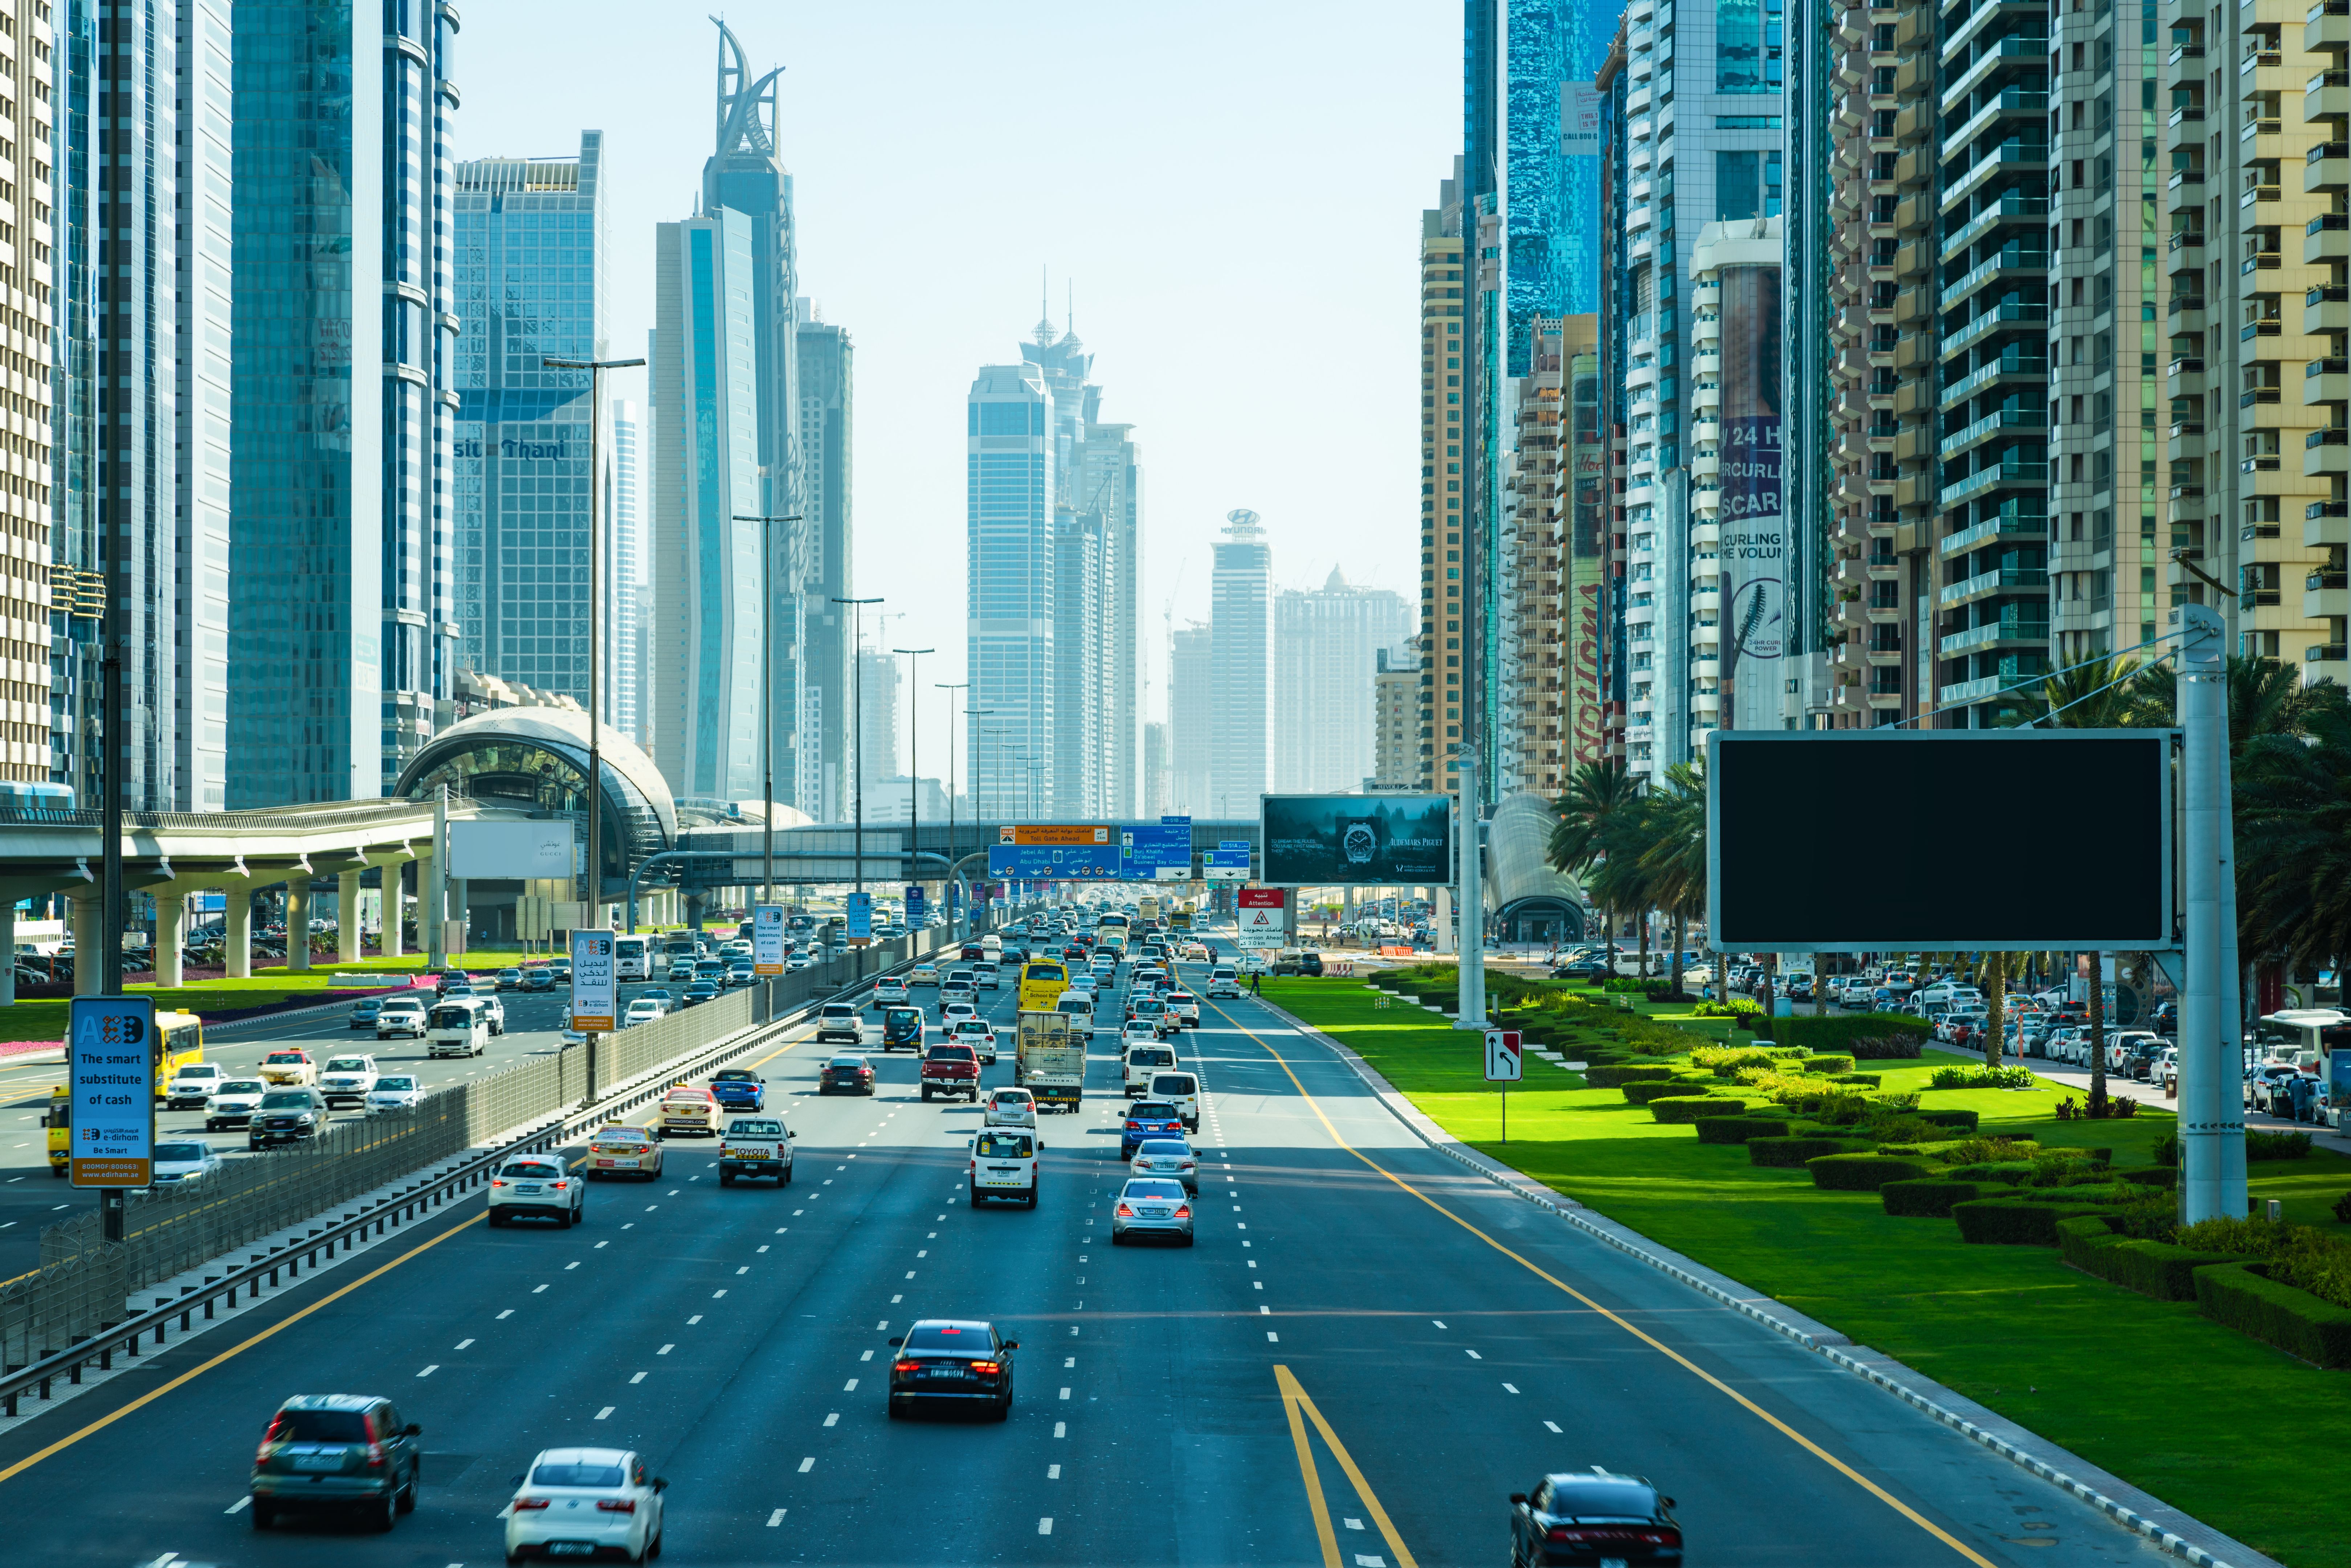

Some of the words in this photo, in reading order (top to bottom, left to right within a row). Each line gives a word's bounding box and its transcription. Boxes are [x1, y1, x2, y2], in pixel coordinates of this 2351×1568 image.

[1732, 426, 1758, 445] 24
[454, 439, 482, 458] sit
[501, 438, 564, 462] Thani
[1725, 533, 1780, 546] CURLING
[540, 841, 560, 850] غوتشي
[580, 960, 607, 968] البديل
[579, 970, 607, 979] الذكي
[81, 1054, 103, 1064] The
[106, 1054, 141, 1064] smart
[79, 1074, 142, 1085] substitute
[89, 1095, 102, 1104] of
[105, 1095, 132, 1104] cash
